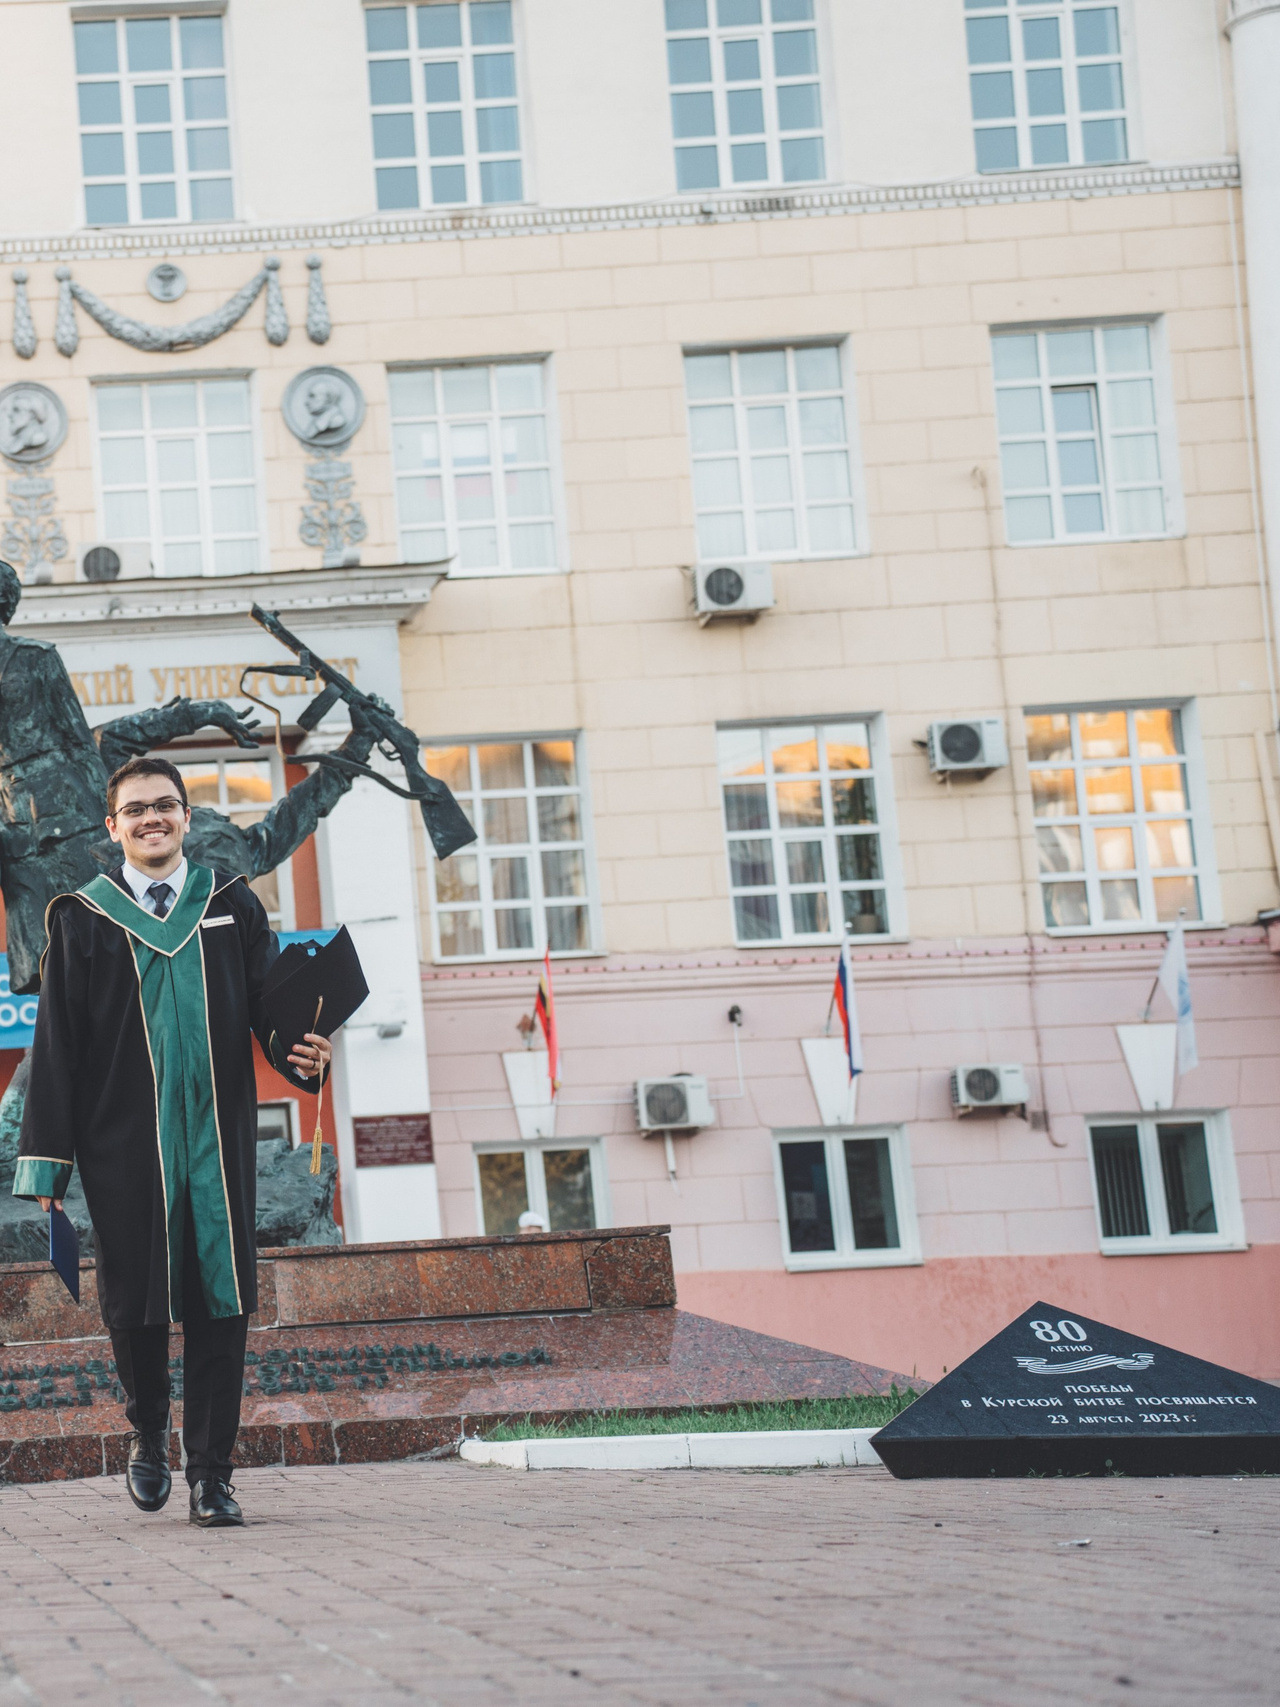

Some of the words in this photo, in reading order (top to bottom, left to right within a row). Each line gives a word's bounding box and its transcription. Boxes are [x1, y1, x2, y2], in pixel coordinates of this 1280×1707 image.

[1029, 1319, 1088, 1343] 80
[243, 1341, 441, 1366] БОТНИКАМ
[1049, 1344, 1094, 1353] ЛЕТИЮ
[1064, 1384, 1134, 1394] ПОБЕДЫ
[981, 1396, 1063, 1408] КУРСКОЙ
[1073, 1397, 1126, 1406] БИТВЕ
[1134, 1396, 1258, 1406] ПОСВЯЩАЕТСЯ
[1047, 1414, 1070, 1424] 23
[1078, 1415, 1134, 1424] АВГУСТА
[1138, 1413, 1182, 1423] 2023
